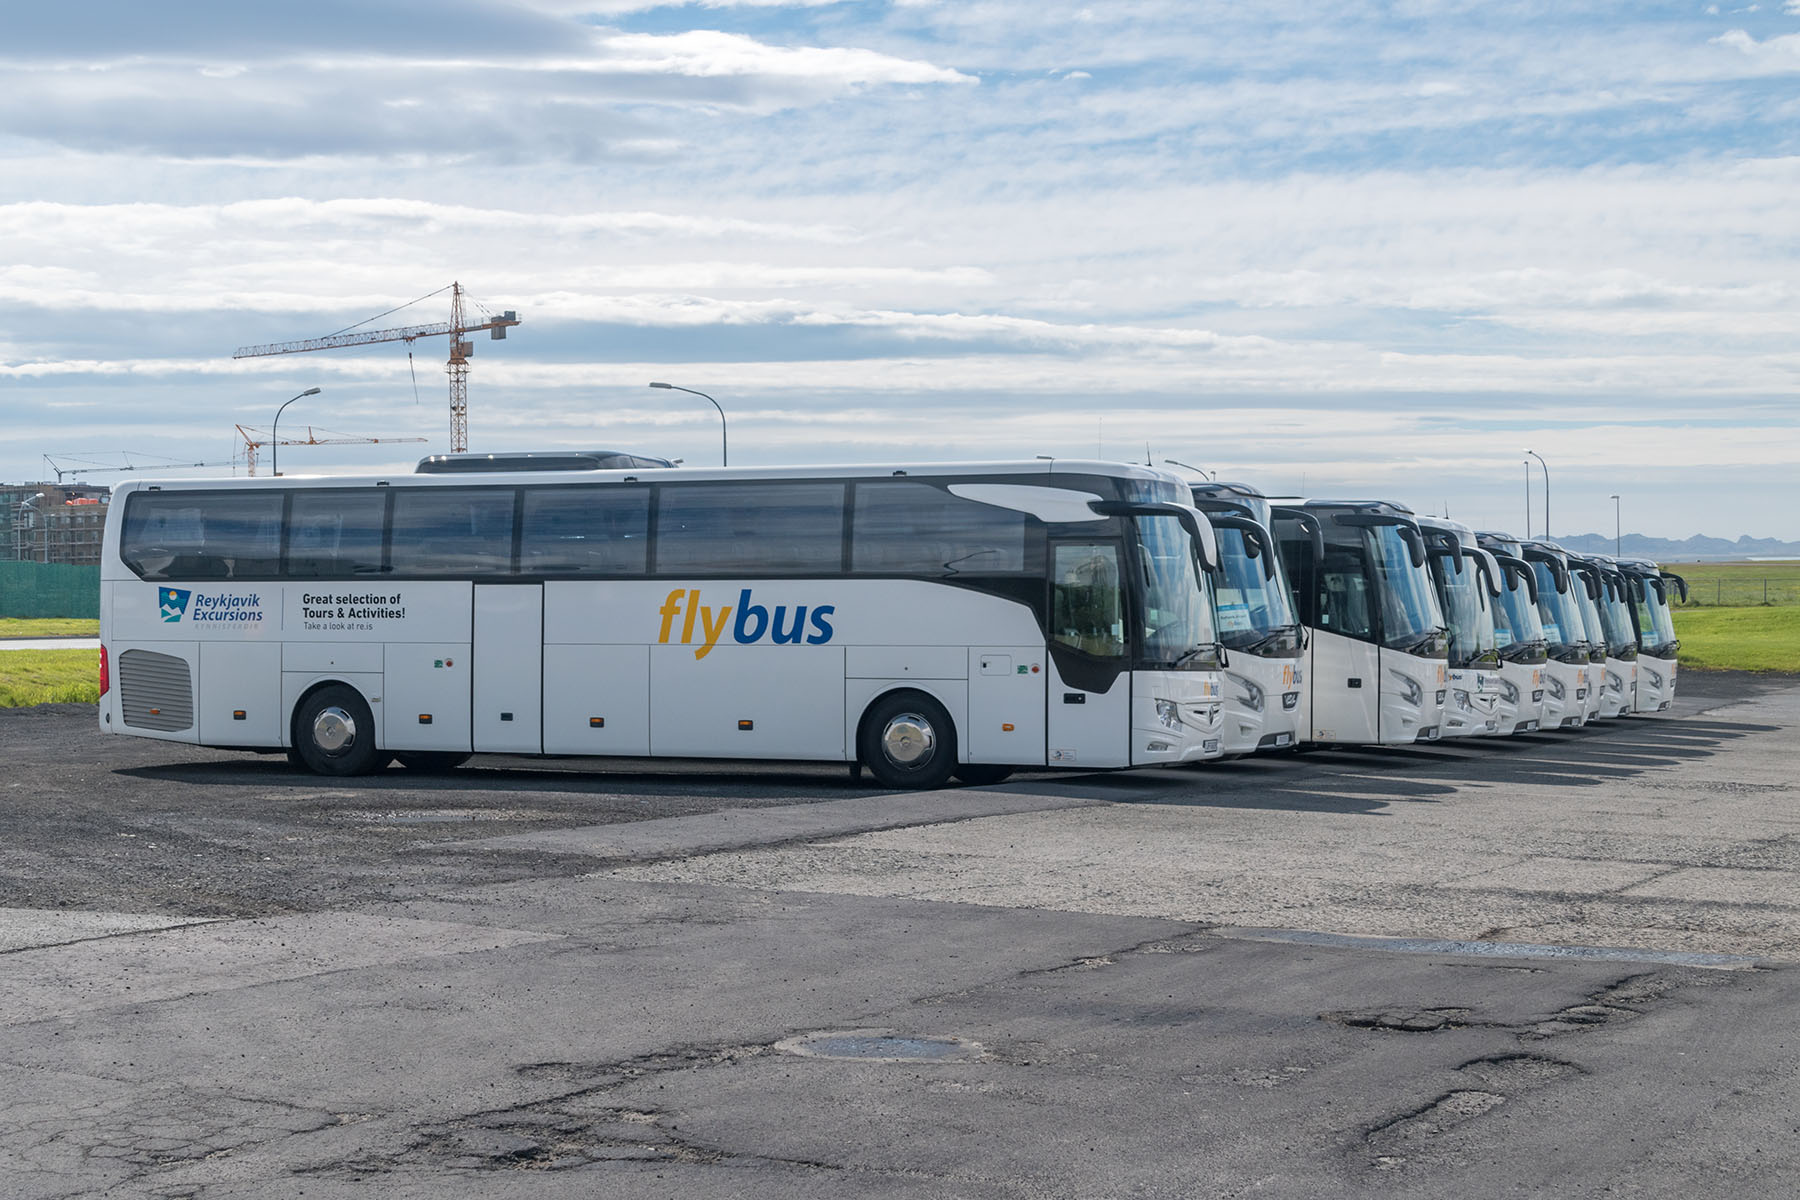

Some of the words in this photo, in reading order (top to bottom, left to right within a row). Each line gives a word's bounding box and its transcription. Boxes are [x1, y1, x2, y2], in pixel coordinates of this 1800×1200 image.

[195, 593, 261, 610] Reykjavik
[302, 593, 333, 604] Great
[335, 593, 387, 604] selection
[389, 593, 402, 604] of
[193, 608, 263, 621] Excursions
[302, 607, 334, 618] Tours
[336, 607, 345, 619] &
[348, 607, 406, 619] Activities!
[304, 621, 321, 630] Take
[329, 621, 346, 630] look
[356, 622, 374, 631] re.is
[658, 589, 836, 661] flybus
